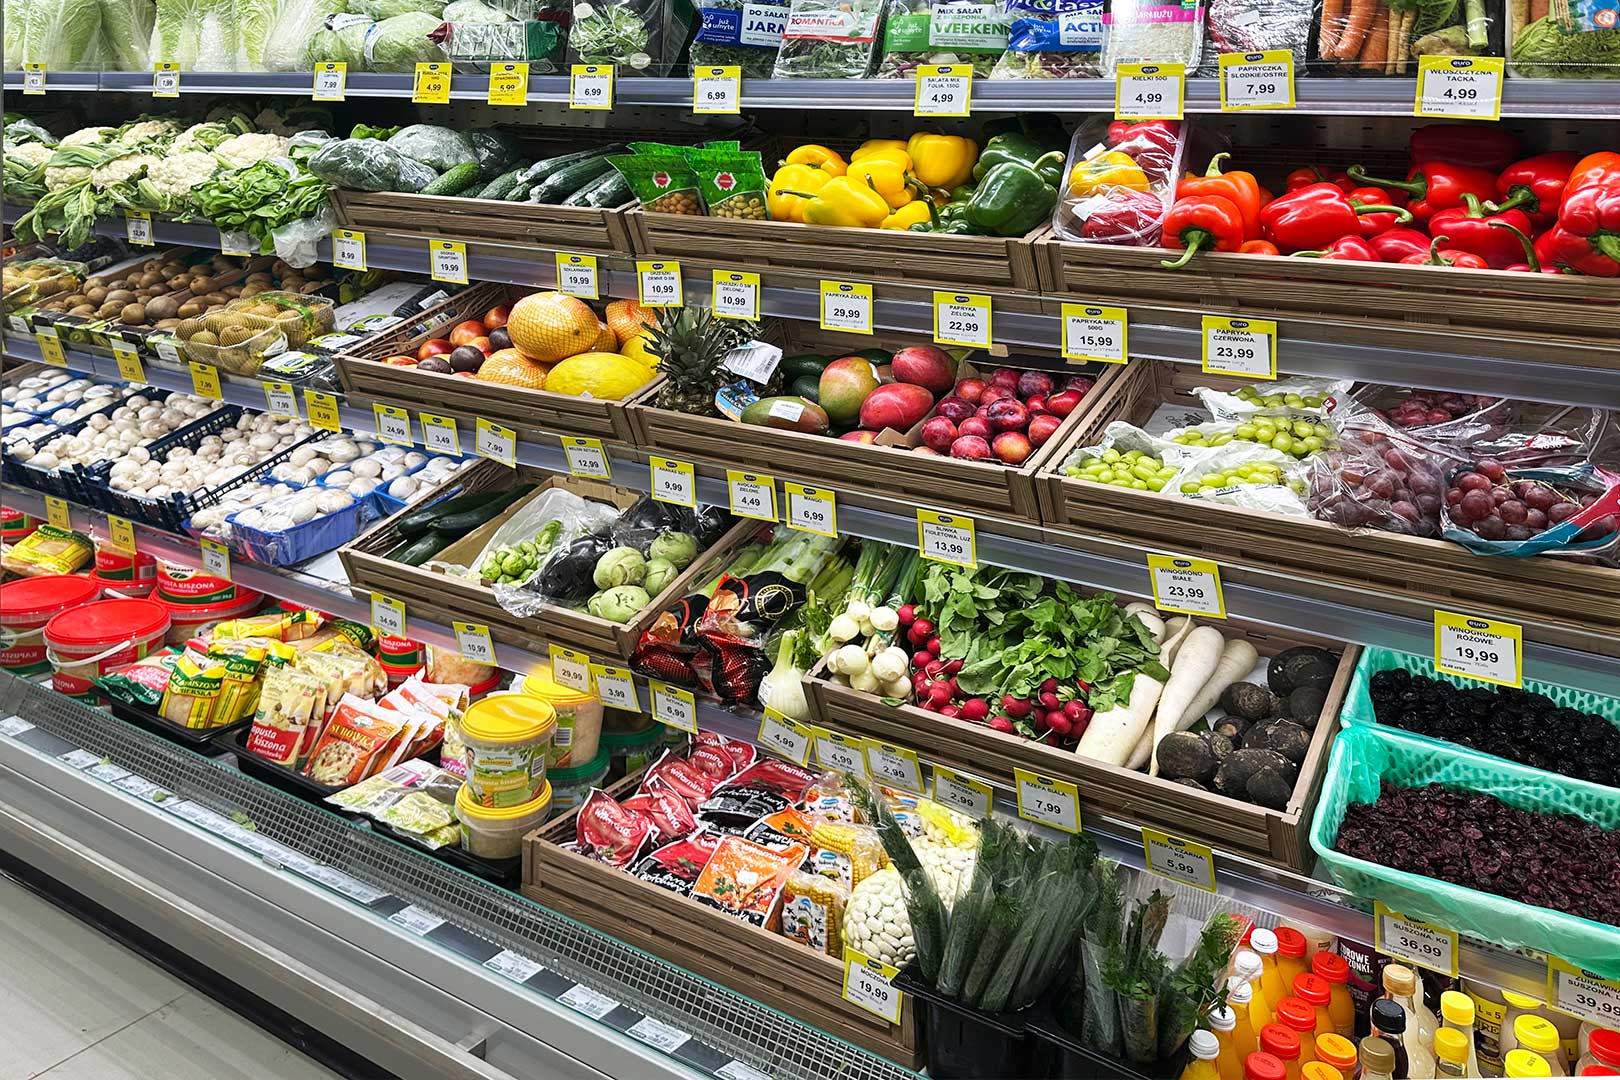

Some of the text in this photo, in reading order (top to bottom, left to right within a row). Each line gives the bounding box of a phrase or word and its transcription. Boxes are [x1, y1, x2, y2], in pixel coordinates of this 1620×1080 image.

[712, 23, 735, 31] umyte
[791, 17, 845, 27] ROMANTICA
[323, 81, 338, 89] 7,99
[426, 84, 441, 92] 4,99
[1246, 84, 1276, 95] 7,99
[584, 88, 602, 98] 6,99
[707, 91, 726, 101] 6,99
[931, 94, 954, 103] 4,99
[1135, 93, 1162, 104] 4,99
[1443, 88, 1477, 100] 4,99
[341, 251, 355, 260] 8,99
[440, 263, 459, 272] 19,99
[568, 276, 590, 285] 19,99
[651, 285, 674, 293] 10,99
[722, 295, 746, 306] 10,99
[833, 308, 860, 319] 29,99
[949, 304, 977, 312] PAPRYKA
[949, 320, 979, 332] 22,99
[1216, 329, 1251, 337] PAPRYKA
[1079, 335, 1112, 347] 15,99
[1216, 346, 1254, 359] 23,99
[386, 425, 405, 436] 24,99
[435, 434, 450, 445] 3,49
[487, 441, 503, 453] 7,99
[578, 459, 599, 469] 12,99
[664, 481, 683, 493] 9,99
[741, 496, 760, 507] 4,49
[803, 510, 824, 522] 6,99
[934, 541, 963, 554] 13,99
[1159, 567, 1203, 577] WINOGRONO
[1168, 585, 1204, 599] 23,99
[1468, 620, 1488, 628] euro
[1447, 625, 1502, 640] WINOGRONO
[467, 643, 486, 654] 10,99
[1455, 646, 1499, 663] 19,99
[561, 668, 583, 681] 29,99
[607, 687, 626, 699] 3,99
[666, 705, 686, 719] 6,99
[254, 735, 287, 752] kiszona
[773, 732, 795, 749] 4,99
[831, 753, 853, 766] 4,99
[882, 765, 905, 779] 2,99
[1026, 781, 1047, 792] RZEPA
[950, 792, 974, 808] 2,99
[1035, 799, 1062, 815] 7,99
[1151, 839, 1205, 861] RZEPA CZARNA
[1167, 858, 1194, 874] 5,99
[1399, 936, 1442, 957] 36,99
[1435, 936, 1448, 946] KG
[860, 968, 890, 988] MOCZONA
[858, 980, 888, 1001] 19,99
[1575, 993, 1620, 1017] 39,99
